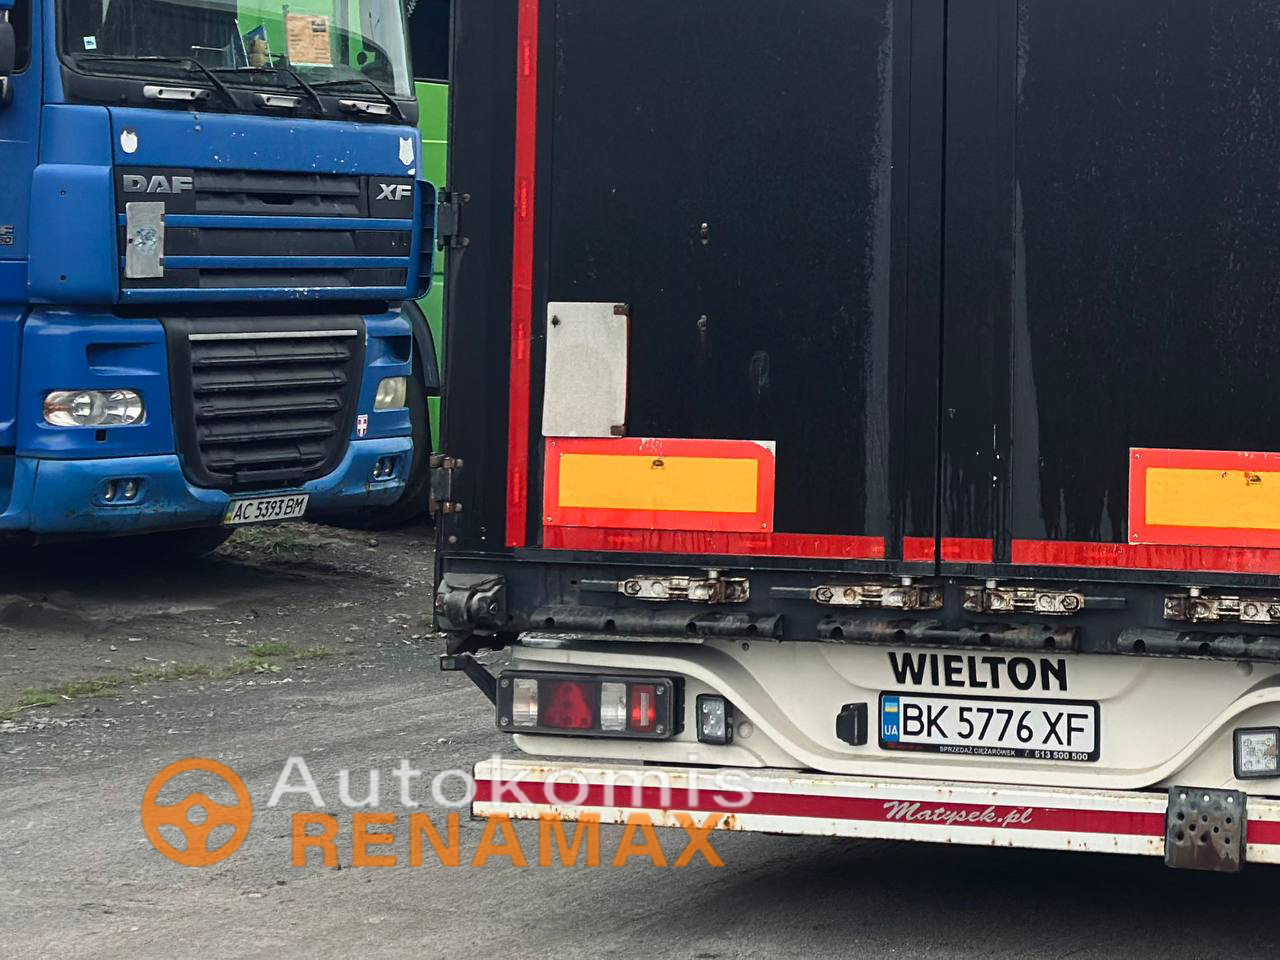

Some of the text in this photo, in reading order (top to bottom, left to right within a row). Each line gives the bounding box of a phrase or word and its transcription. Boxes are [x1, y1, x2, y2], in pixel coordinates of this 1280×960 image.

[123, 174, 193, 194] DAF
[375, 183, 412, 201] XF
[232, 497, 305, 521] AC 5393 BM
[887, 651, 1068, 692] WIELTON
[884, 725, 899, 736] UA
[903, 703, 1089, 747] BK 5776 XF
[939, 745, 973, 755] SPRZEDAŻ
[1034, 750, 1089, 761] 513 500 500
[882, 800, 1033, 828] Matysek.pl
